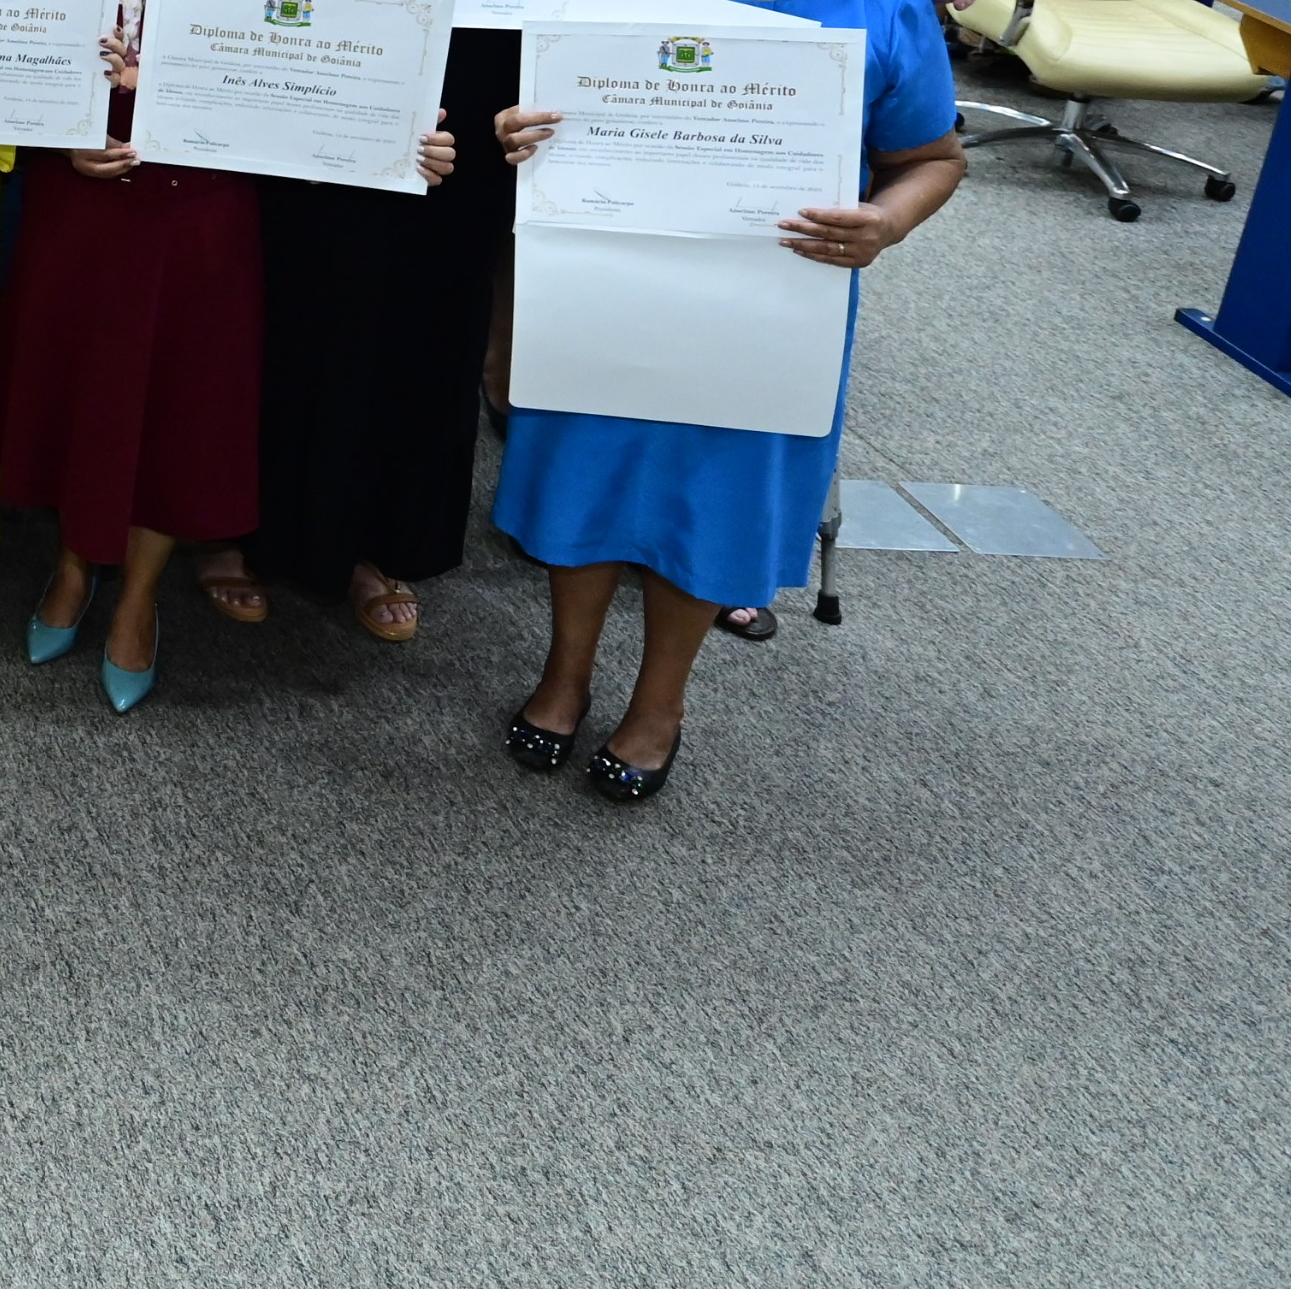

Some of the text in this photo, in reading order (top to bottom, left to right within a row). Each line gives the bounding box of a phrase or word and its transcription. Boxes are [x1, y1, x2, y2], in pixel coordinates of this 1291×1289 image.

[23, 8, 66, 20] Mérito
[189, 24, 383, 55] Diploma de Honra ao Mérito
[15, 54, 71, 65] Magalhães
[210, 43, 361, 67] Câmara Municipal de Goiânia
[222, 75, 336, 95] Inês Alves Simplício
[576, 76, 796, 96] Diploma de Honra ao Mérito
[602, 94, 772, 110] Câmara Municipal de Goiânia
[587, 127, 782, 145] Maria Gisele Barbosa da Silva
